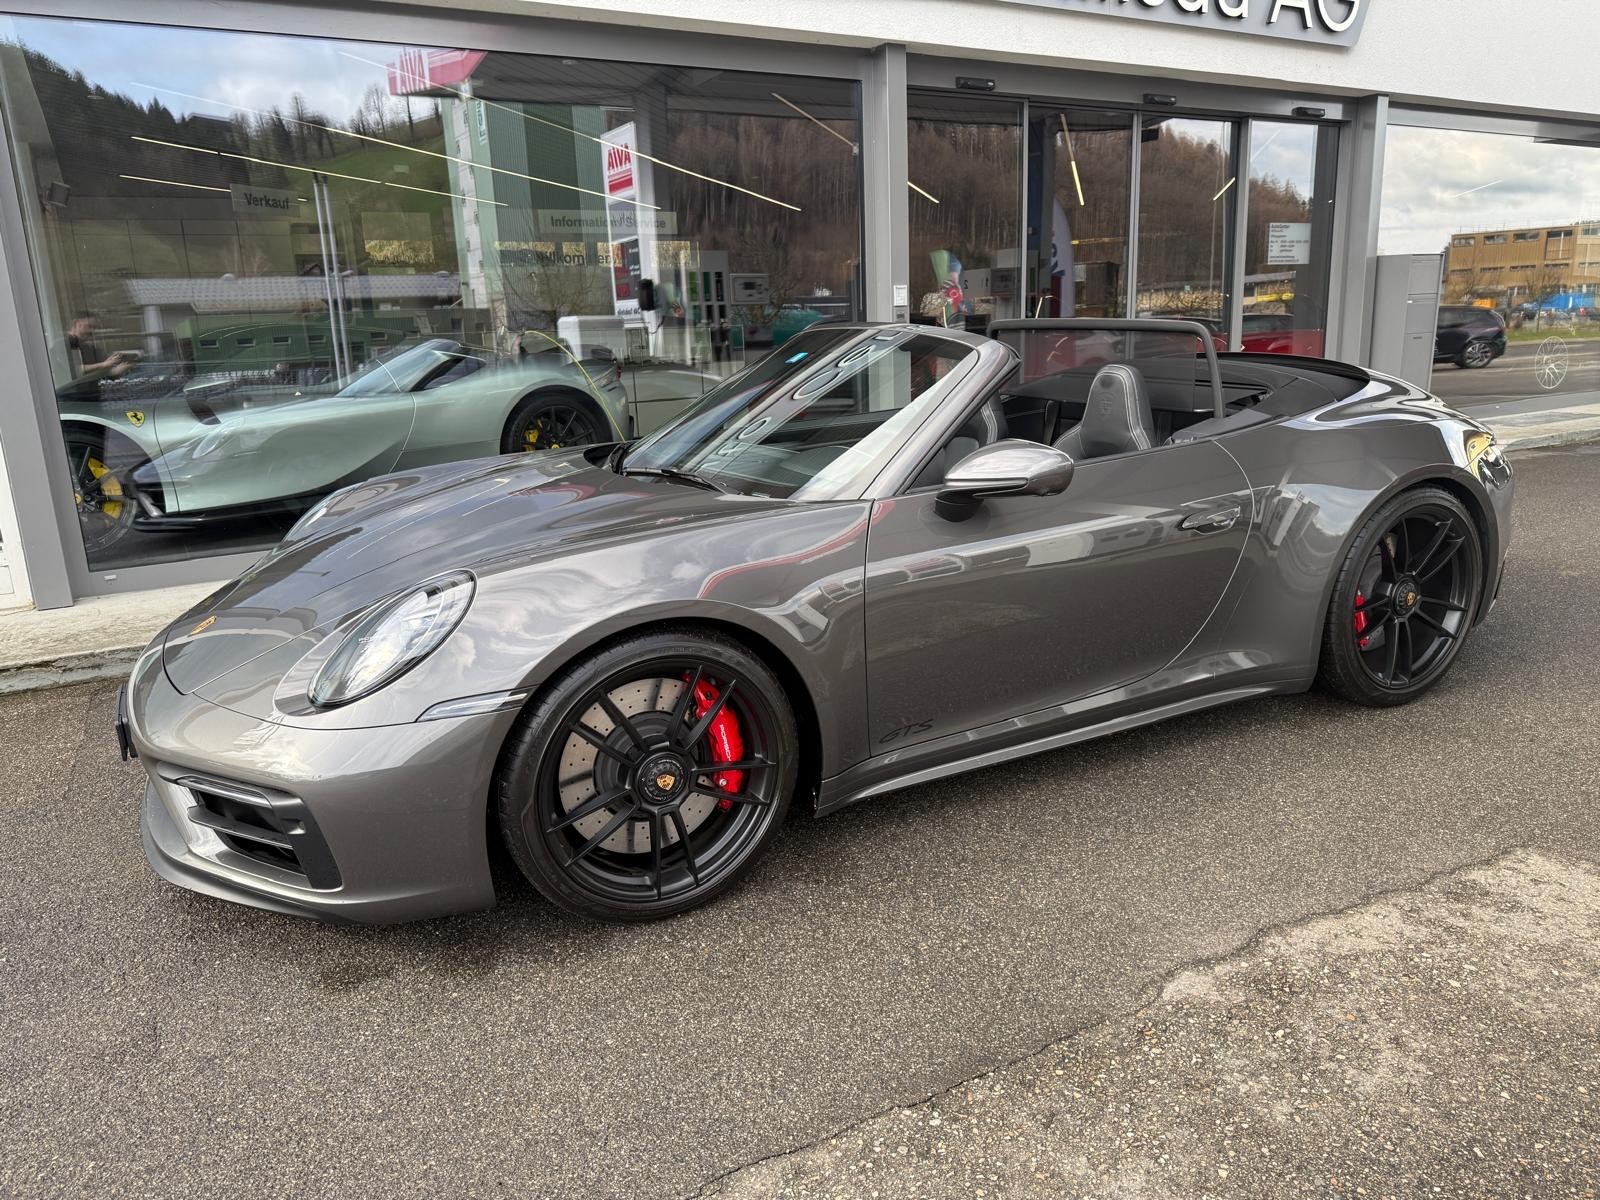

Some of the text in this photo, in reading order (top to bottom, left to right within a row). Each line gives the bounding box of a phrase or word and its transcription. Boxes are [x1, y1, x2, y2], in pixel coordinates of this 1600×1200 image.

[244, 192, 290, 209] Verkauf
[719, 724, 732, 762] PORSC
[880, 718, 934, 744] GTS
